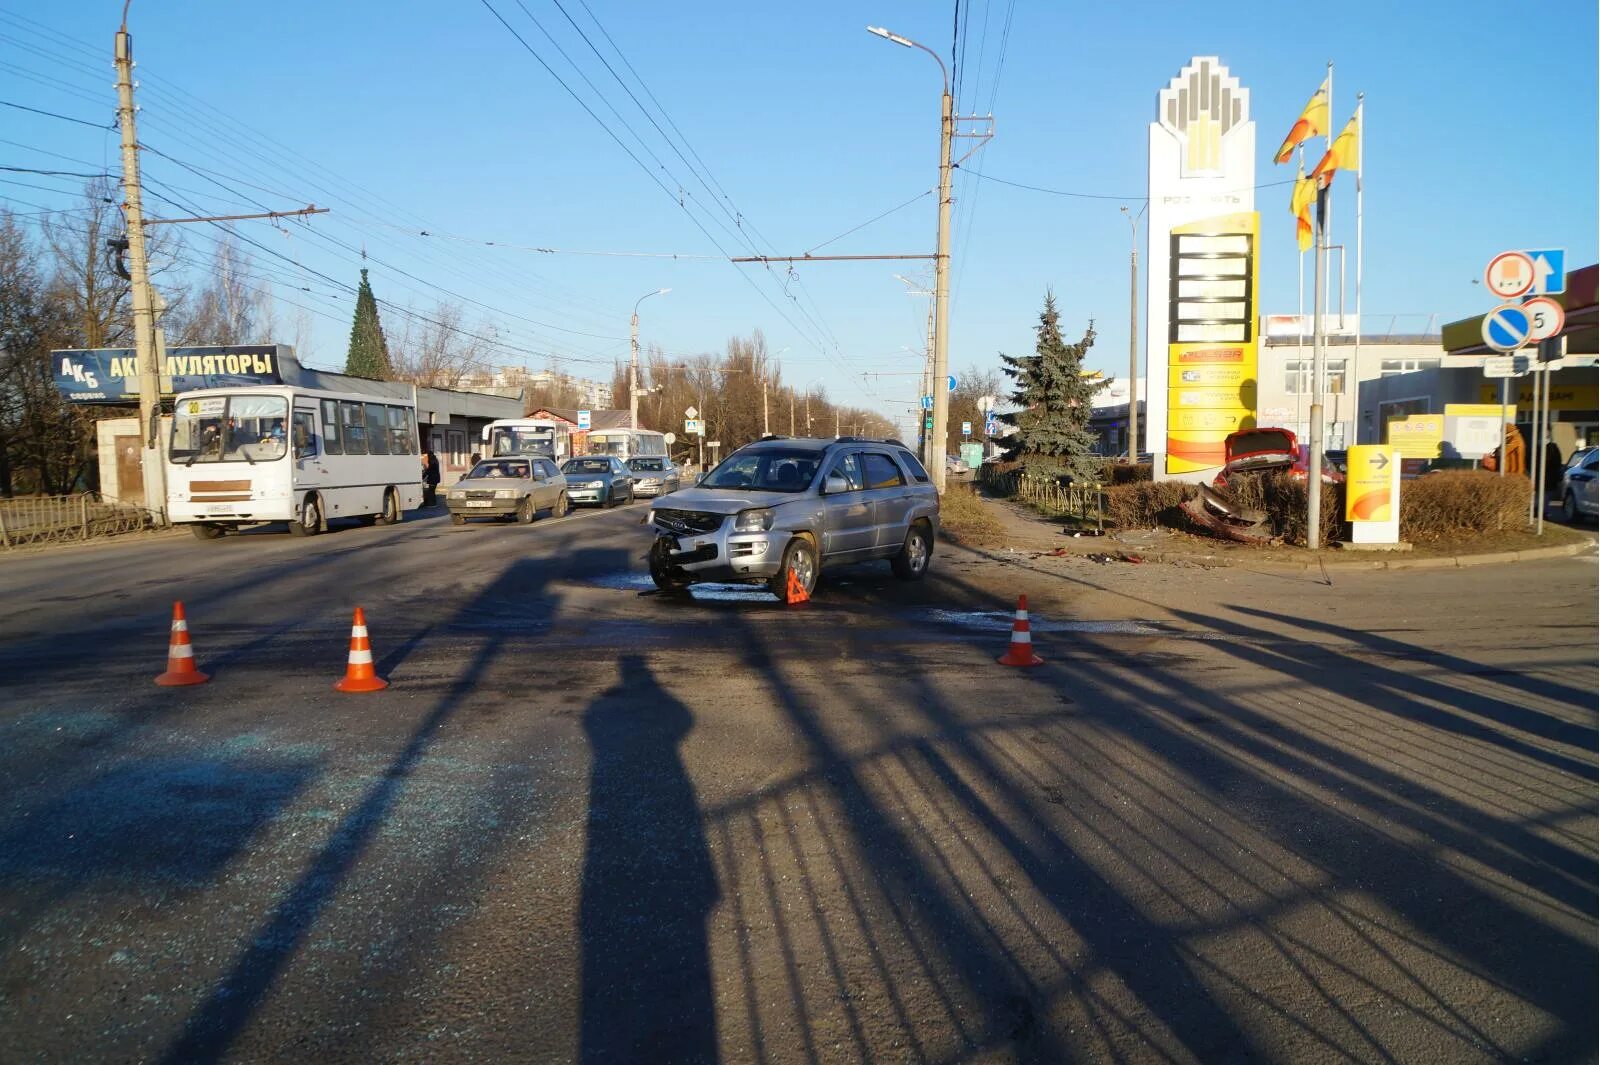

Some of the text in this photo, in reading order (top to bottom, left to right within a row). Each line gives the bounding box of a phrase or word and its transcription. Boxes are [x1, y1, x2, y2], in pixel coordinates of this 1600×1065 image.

[1534, 312, 1545, 329] 5
[62, 357, 99, 389] АКБ
[110, 353, 273, 378] АКМУЛЯТОРЫ
[189, 401, 200, 414] 20
